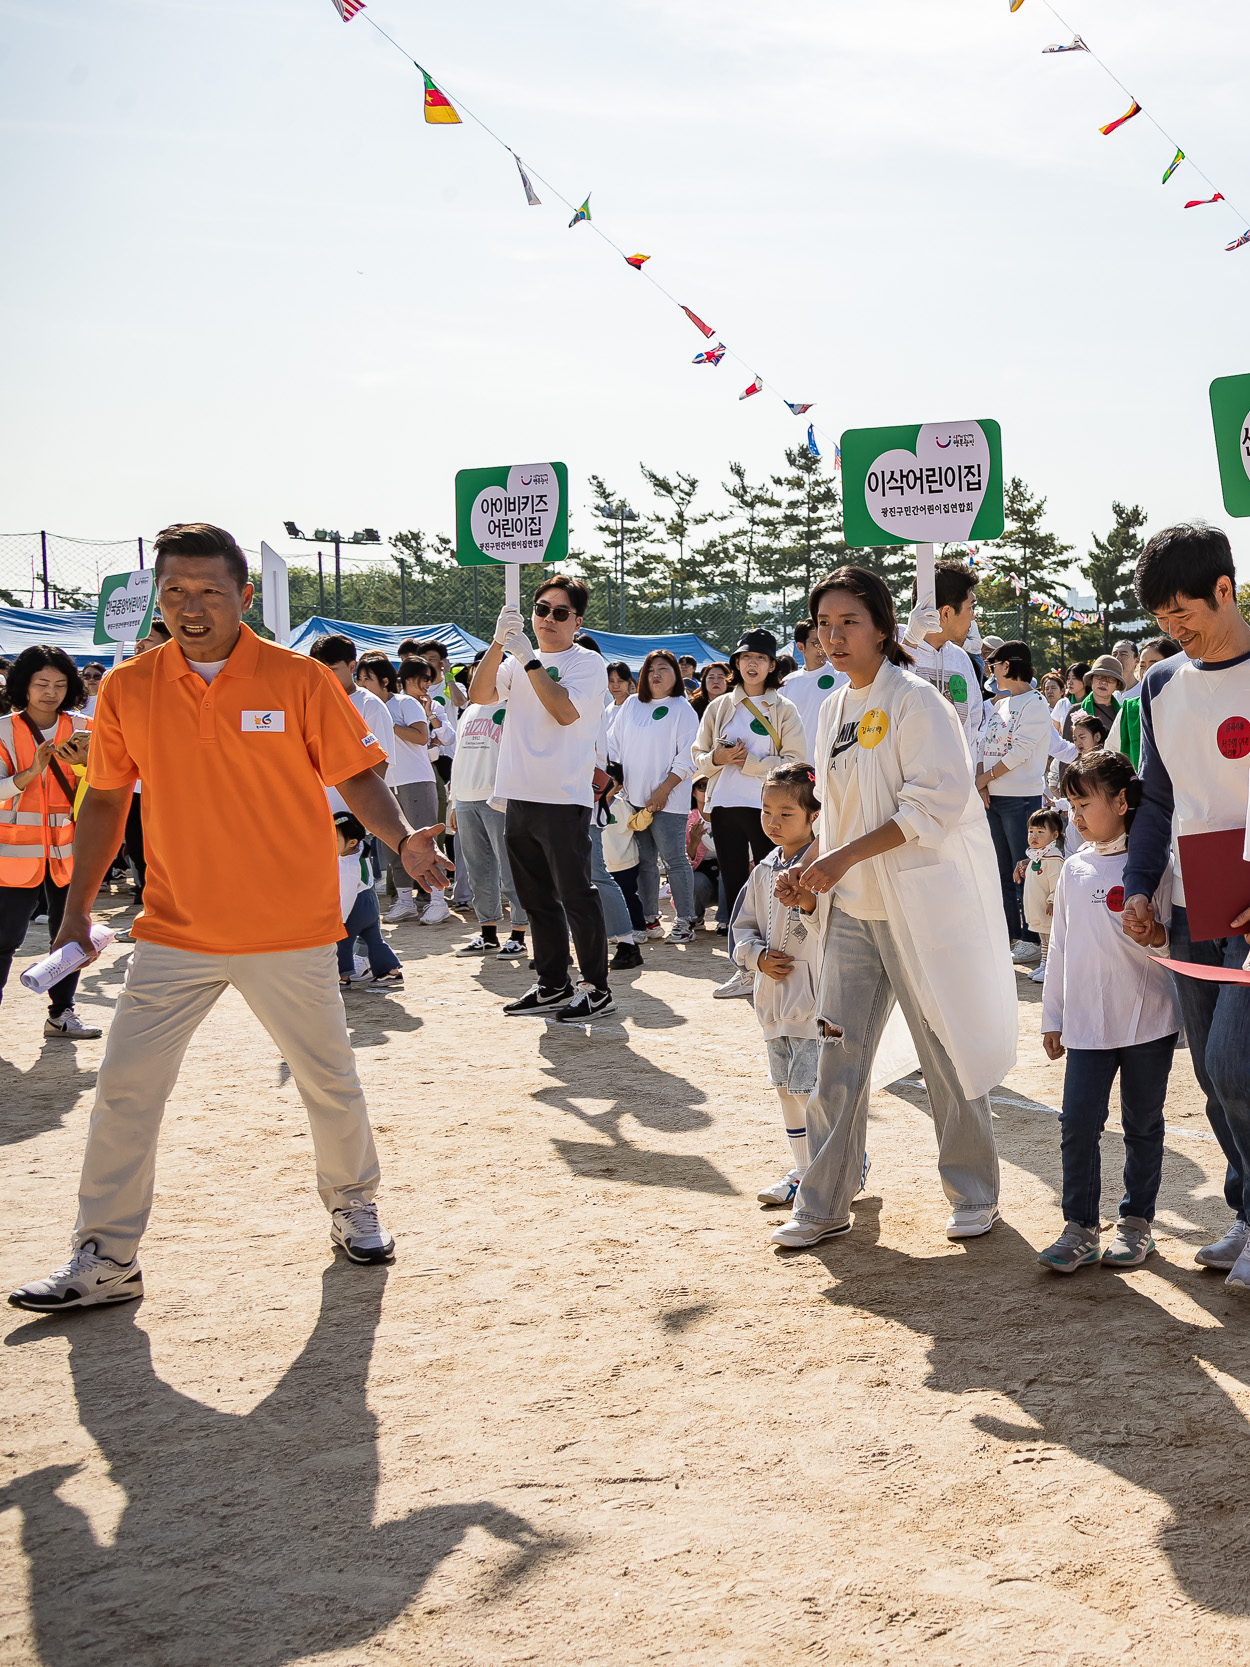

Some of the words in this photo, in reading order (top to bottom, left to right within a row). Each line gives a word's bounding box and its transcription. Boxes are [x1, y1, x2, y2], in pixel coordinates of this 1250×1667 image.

[867, 463, 982, 497] 이삭어린이집
[480, 494, 549, 518] 아이비키즈
[880, 501, 974, 518] 광진구민간어린이집연합회
[487, 515, 542, 538] 어린이집
[479, 539, 544, 551] 광진구민간어린이집연합회
[837, 720, 860, 743] NIK
